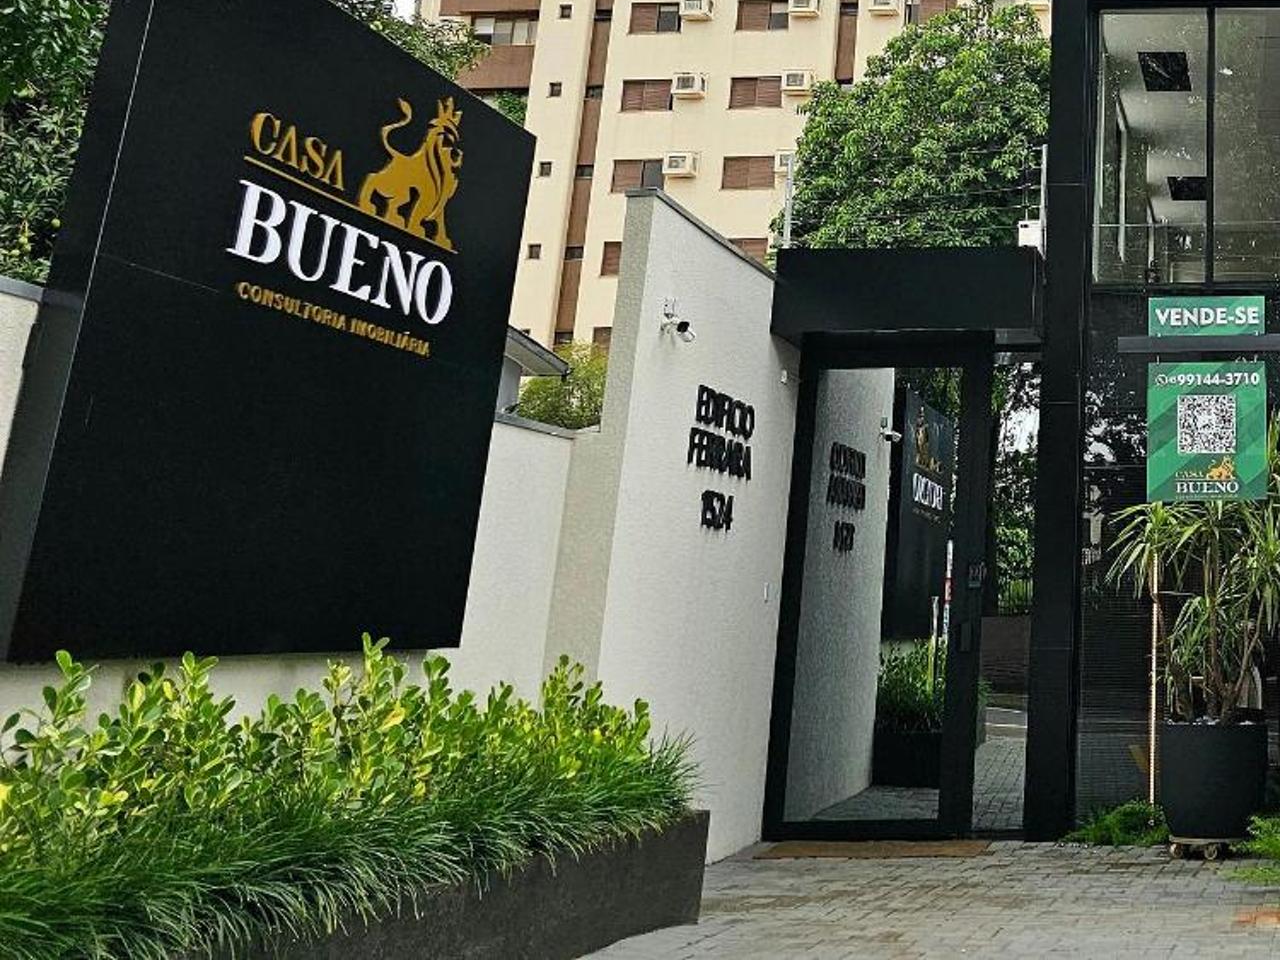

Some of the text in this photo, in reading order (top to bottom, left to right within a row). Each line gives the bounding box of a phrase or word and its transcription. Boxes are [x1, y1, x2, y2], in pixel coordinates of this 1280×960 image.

[252, 112, 344, 191] CASA
[226, 179, 454, 325] BUENO
[237, 281, 347, 331] CONSULTORIA
[1155, 307, 1260, 326] VENDE-SE
[1175, 481, 1239, 493] BUENO
